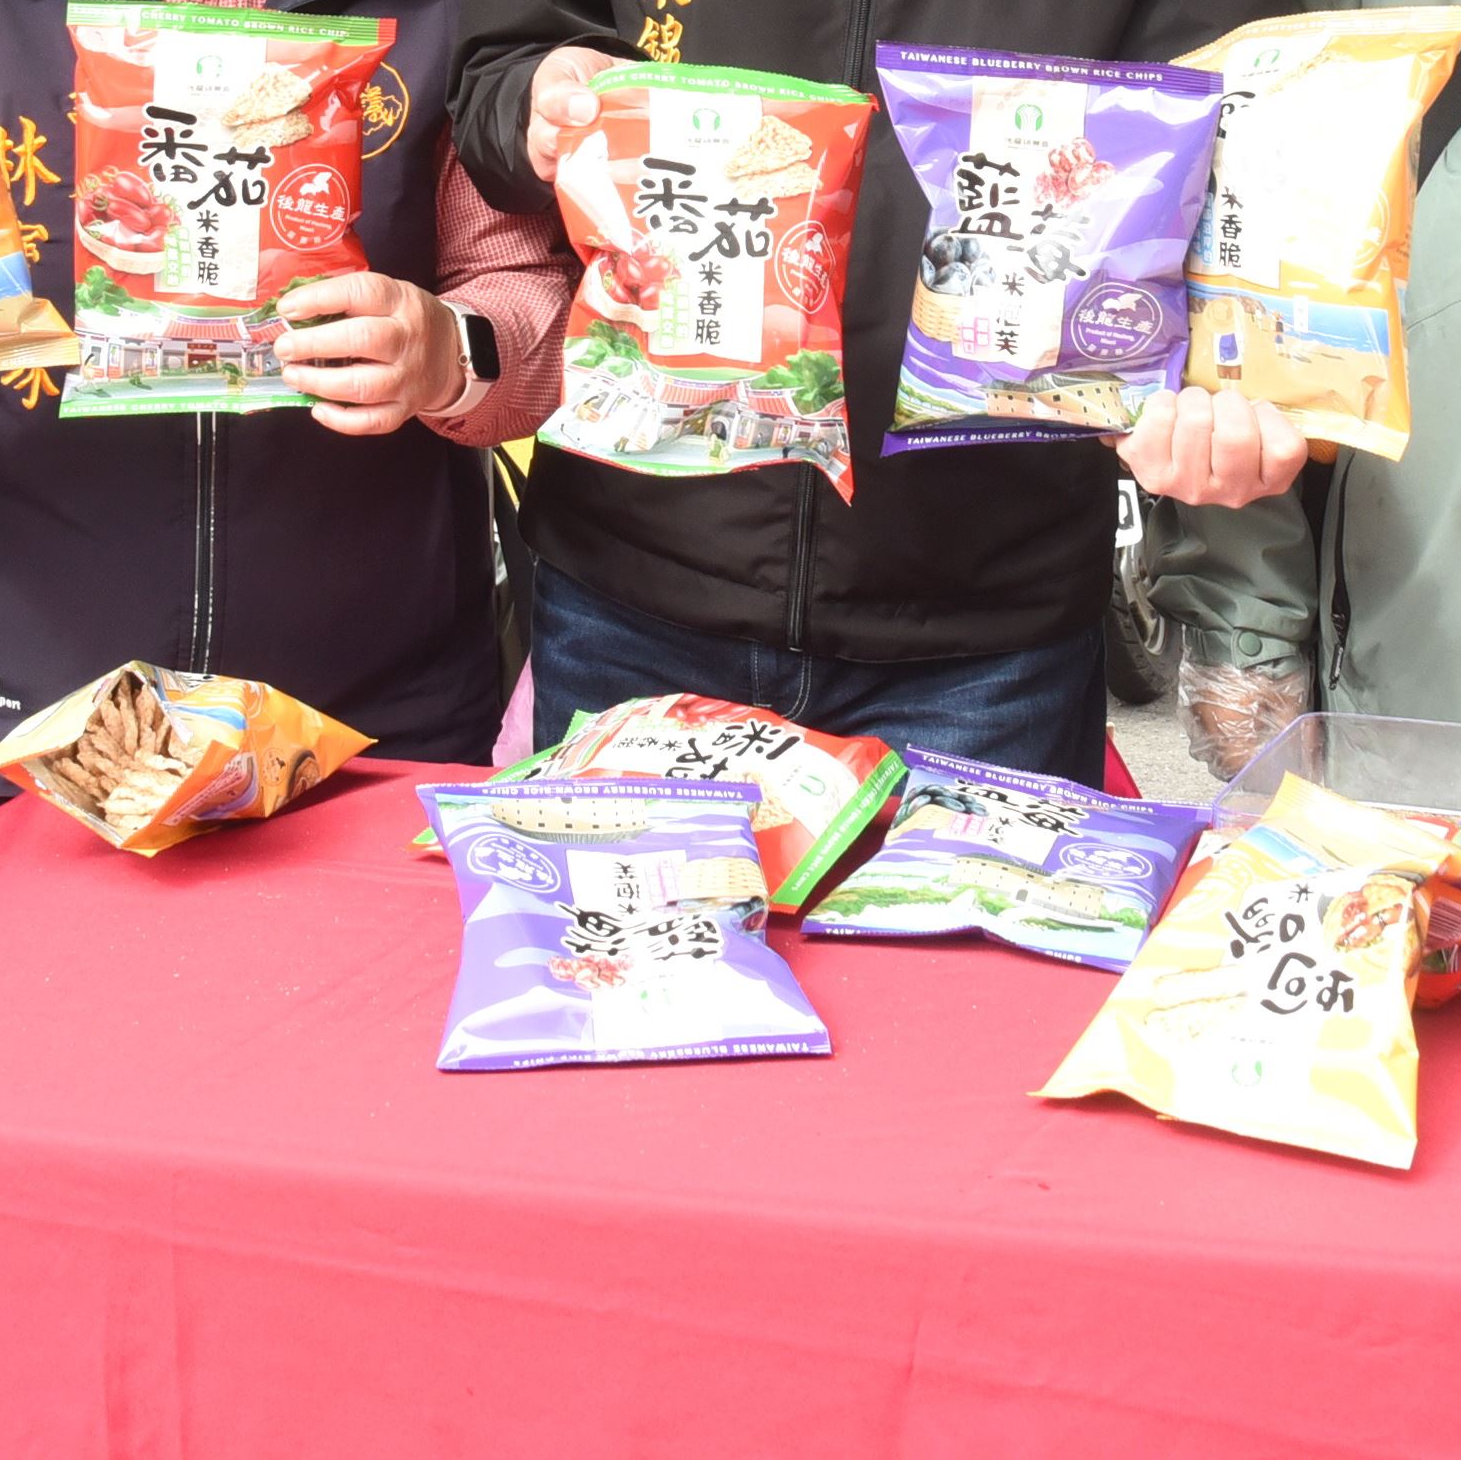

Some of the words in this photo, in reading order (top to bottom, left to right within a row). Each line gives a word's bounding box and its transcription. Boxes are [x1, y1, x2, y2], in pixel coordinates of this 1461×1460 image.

[141, 12, 186, 22] CHERRY
[190, 15, 240, 27] TOMATO
[243, 20, 284, 32] BROWN
[288, 25, 315, 35] RICE
[900, 51, 968, 65] TAIWANESE
[972, 58, 1040, 71] BLUEBERRY
[1045, 64, 1089, 76] BROWN
[1093, 69, 1121, 78] RICE
[1126, 71, 1163, 81] CHIPS
[630, 73, 676, 84] CHERRY
[682, 77, 730, 88] TOMATO
[735, 81, 776, 93] BROWN
[779, 88, 806, 98] RICE
[141, 105, 272, 210] 番茄
[277, 193, 346, 223] 後龍生產
[637, 157, 775, 261] 番茄
[951, 153, 1089, 284] 藍莓
[1220, 186, 1244, 269] 米香脆
[196, 209, 220, 287] 米香脆
[695, 262, 723, 345] 米香脆
[1078, 308, 1154, 335] 後龍生產
[63, 403, 127, 413] TAIWANESE
[131, 402, 176, 412] CHERRY
[907, 434, 966, 445] TAIWANESE
[970, 431, 1031, 441] BLUEBERRY
[604, 786, 672, 796] BLUEBERRY
[676, 788, 743, 798] TAIWANESE
[922, 754, 982, 776] TAIWANESE
[985, 771, 1046, 792] BLUEBERRY
[1049, 784, 1088, 803] BROWN
